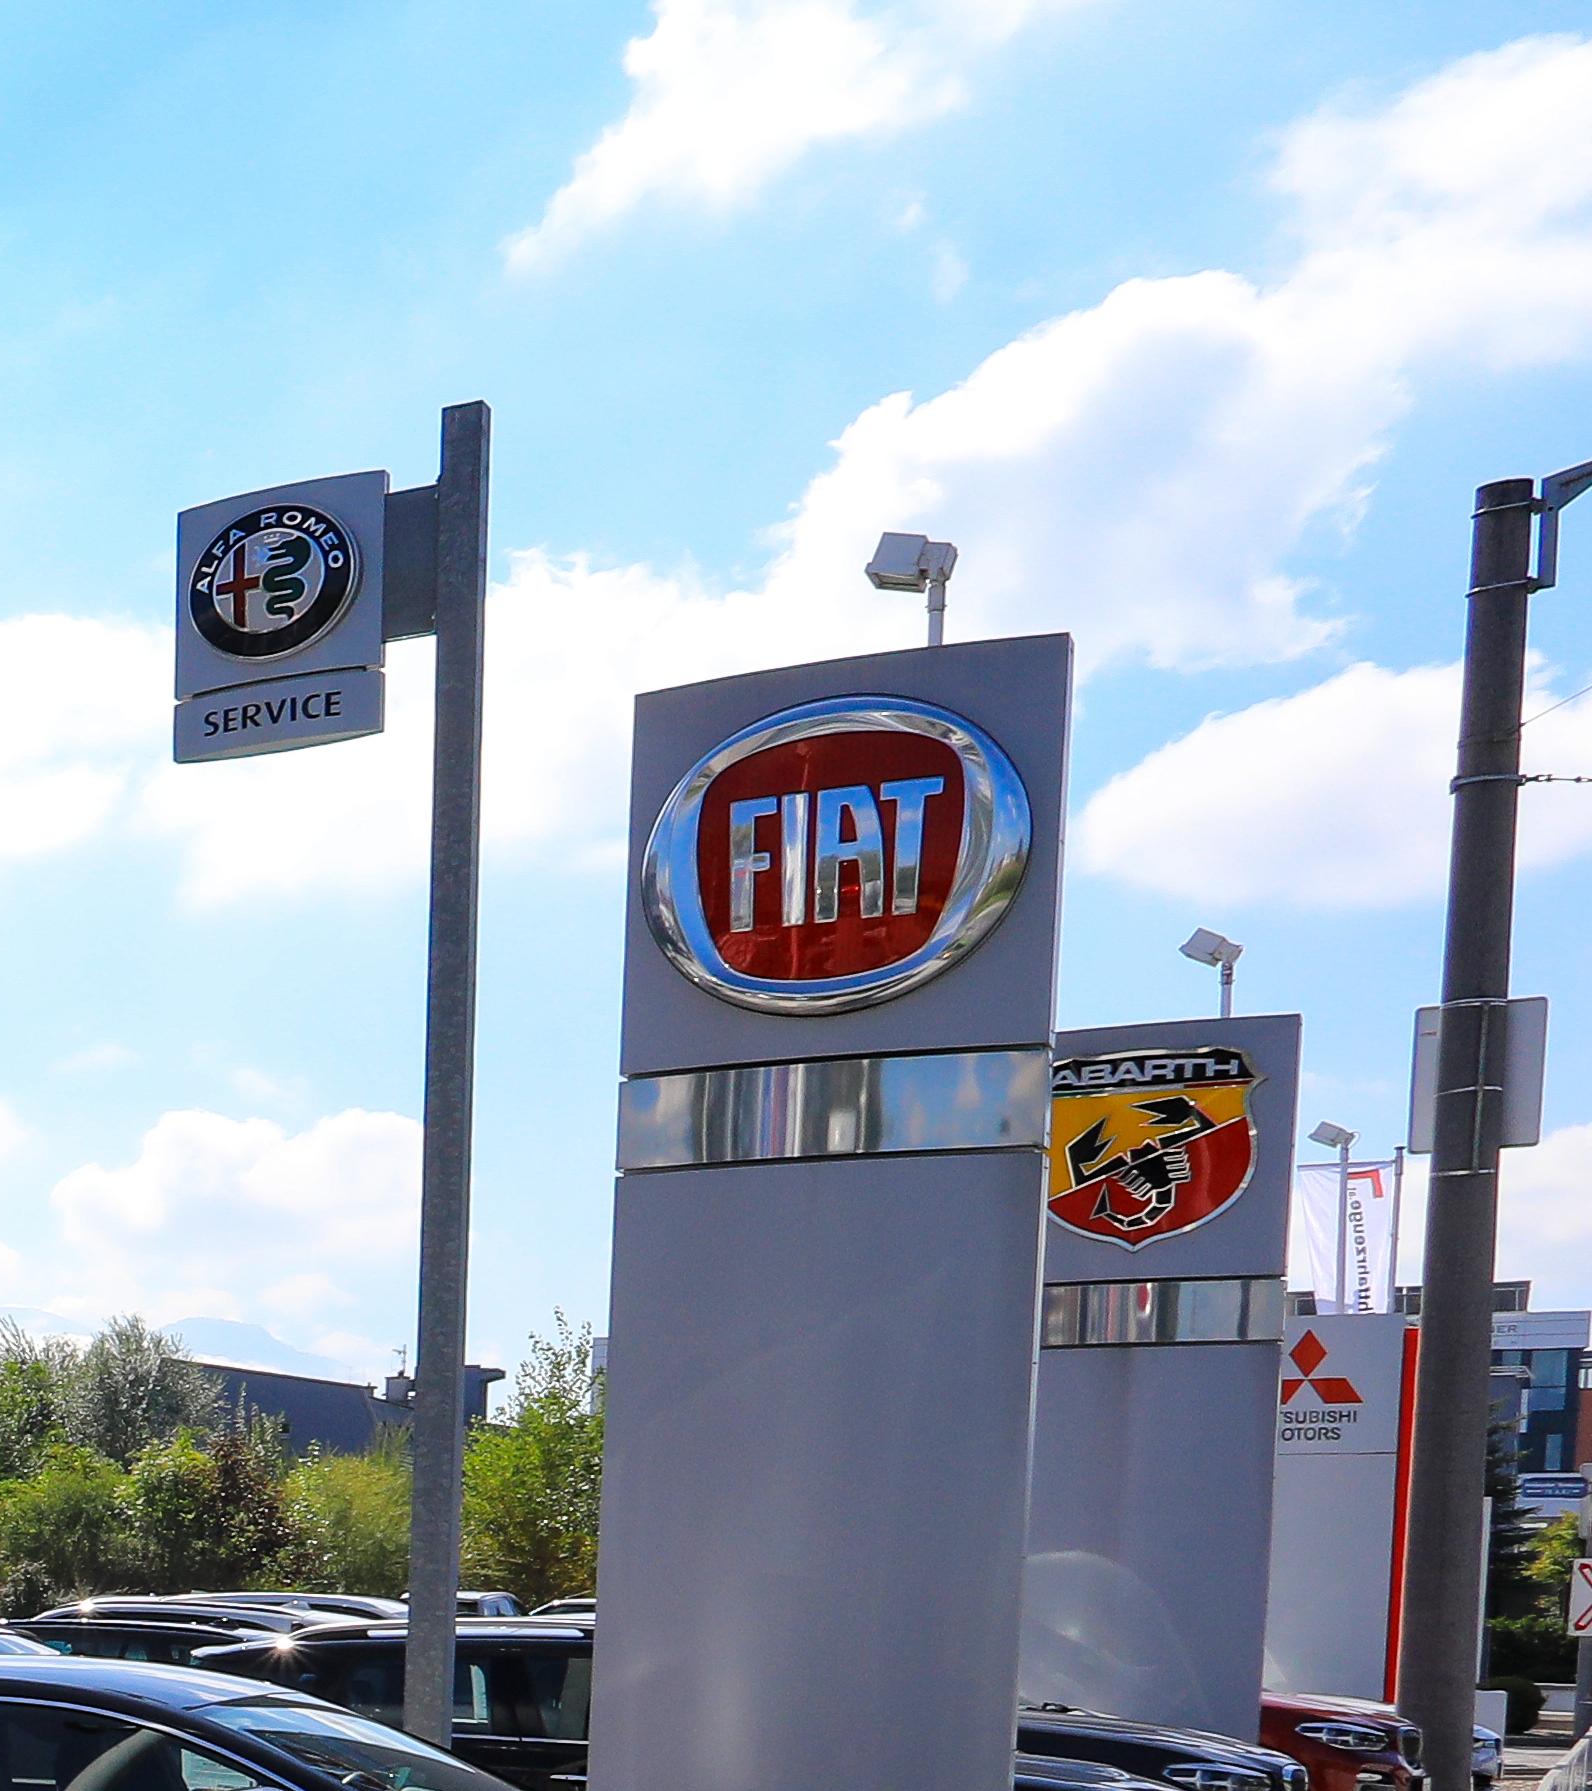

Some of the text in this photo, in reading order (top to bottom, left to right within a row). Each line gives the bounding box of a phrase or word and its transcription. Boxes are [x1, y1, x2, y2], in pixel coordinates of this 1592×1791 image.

[196, 510, 344, 595] ALFA ROMEO
[203, 690, 343, 738] SERVICE
[729, 776, 945, 932] FIAT
[1053, 1058, 1239, 1088] ABARTH
[1280, 1410, 1358, 1424] SUBISHI
[1281, 1427, 1341, 1441] OTORS
